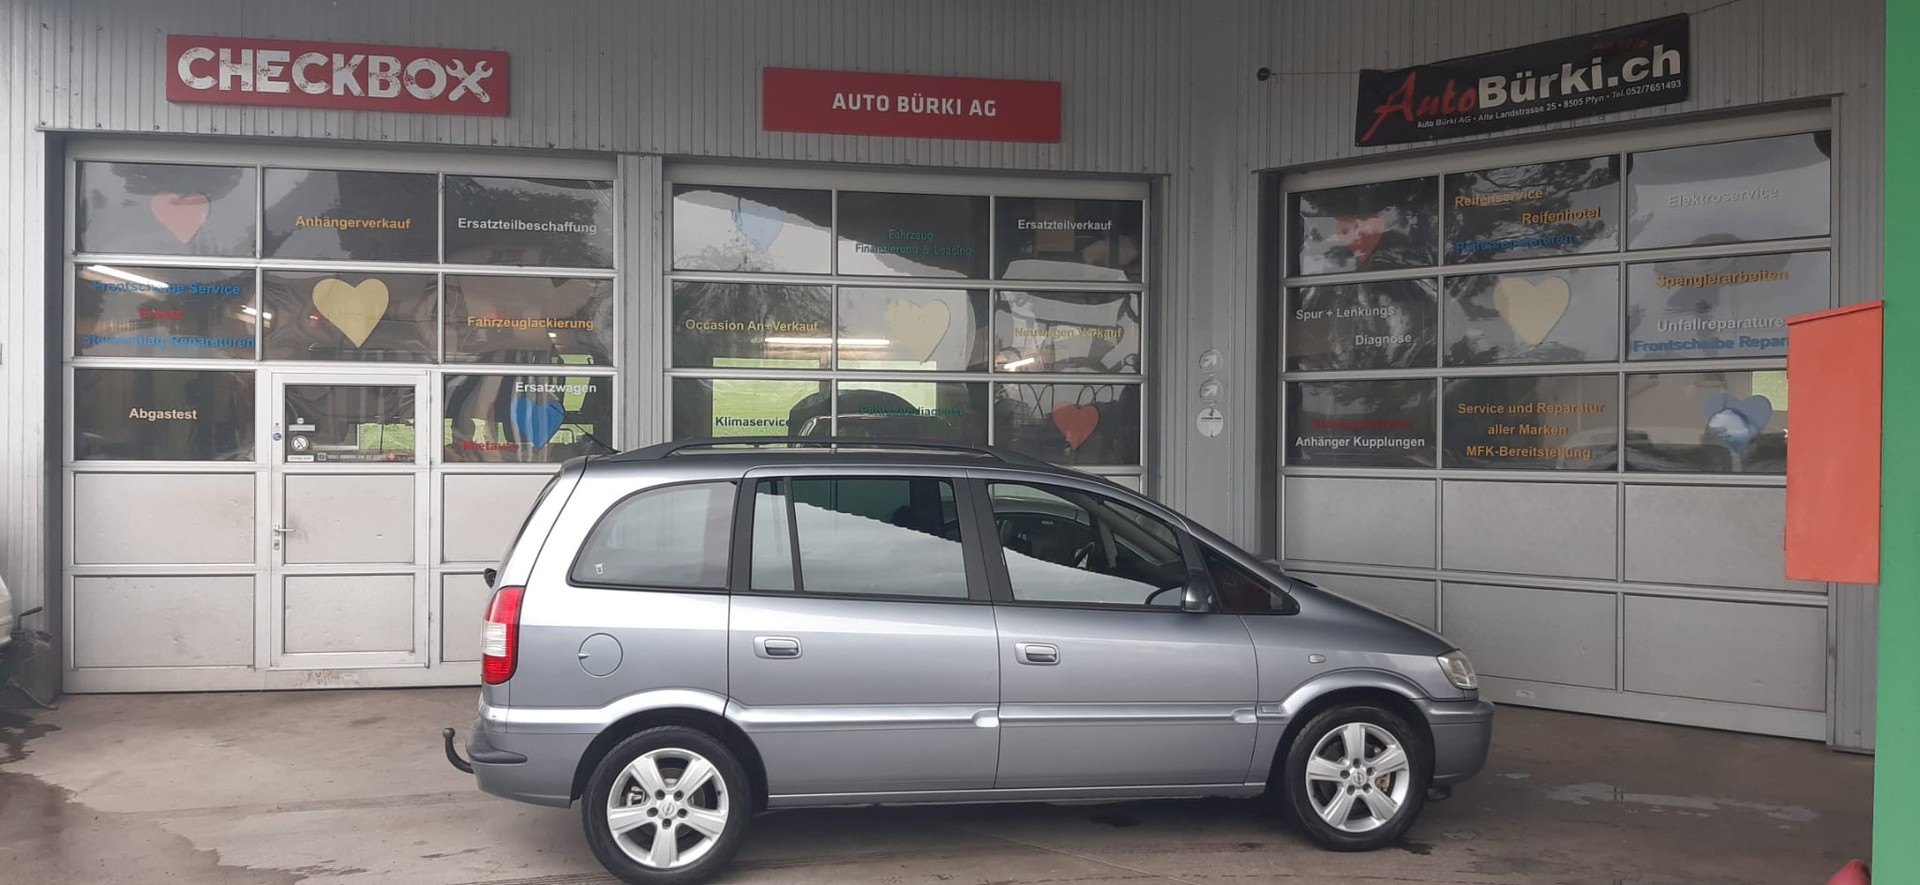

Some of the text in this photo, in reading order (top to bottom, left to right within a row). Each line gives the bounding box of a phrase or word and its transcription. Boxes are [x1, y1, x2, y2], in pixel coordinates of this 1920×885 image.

[177, 46, 494, 104] CHECKBOX
[832, 93, 997, 117] AUTO BÜRKI AG
[1417, 119, 1434, 128] Auto
[1435, 117, 1457, 126] Bürki
[1458, 115, 1471, 123] AG
[1478, 113, 1494, 121] Alte
[1495, 105, 1545, 119] Landstrasse
[1546, 102, 1557, 112] 25
[1563, 98, 1584, 109] 8505
[1585, 95, 1605, 105] Pfyn
[1454, 188, 1545, 207] Reifenservice
[1667, 186, 1780, 208] Elektroservice
[295, 215, 413, 231] Anhängerverkauf
[1521, 206, 1601, 225] Reifenhotel
[457, 216, 598, 235] Ersatzteilbeschaffung
[1017, 219, 1113, 231] Ersatzteilverkauf
[855, 243, 917, 256] Finanzierung
[1655, 269, 1789, 290] Spenglerarbeiten
[188, 282, 241, 295] Service
[1295, 305, 1395, 322] Spur + Lenkungs
[466, 316, 595, 331] Fahrzeuglackierung
[685, 319, 744, 331] Occasion
[1657, 315, 1786, 333] Unfallreparature
[169, 333, 256, 349] Reparaturen
[1355, 333, 1413, 347] Diagnose
[1738, 335, 1790, 350] Repar
[515, 381, 597, 396] Ersatzwagen
[128, 407, 198, 422] Abgastest
[1458, 402, 1606, 415] Service und Reparatur
[715, 416, 791, 428] Klimaservice
[1487, 424, 1569, 436] aller Marken
[1295, 435, 1425, 450] Anhänger Kupplungen
[1465, 446, 1593, 460] MFK-Bereitstellung
